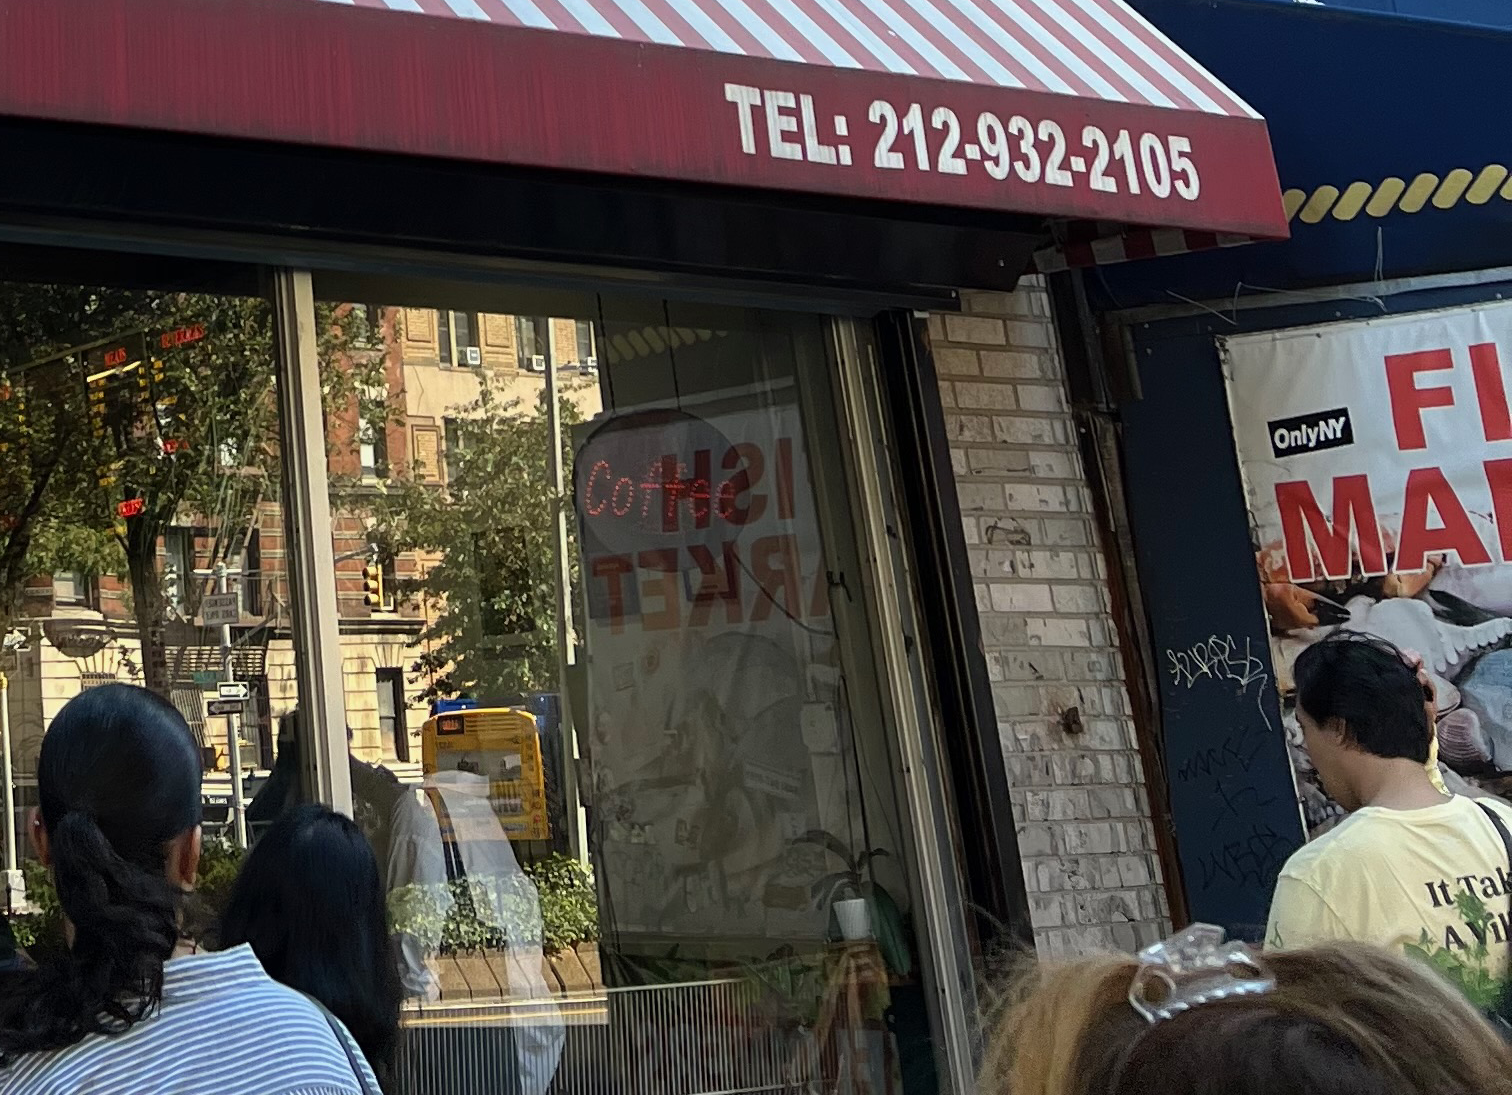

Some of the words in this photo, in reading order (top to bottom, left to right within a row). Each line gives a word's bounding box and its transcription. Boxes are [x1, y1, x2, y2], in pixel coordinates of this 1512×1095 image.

[724, 82, 853, 167] TEL:
[868, 99, 1201, 202] 212-932-2105
[1273, 416, 1347, 450] OnlyNY
[1424, 878, 1455, 908] It
